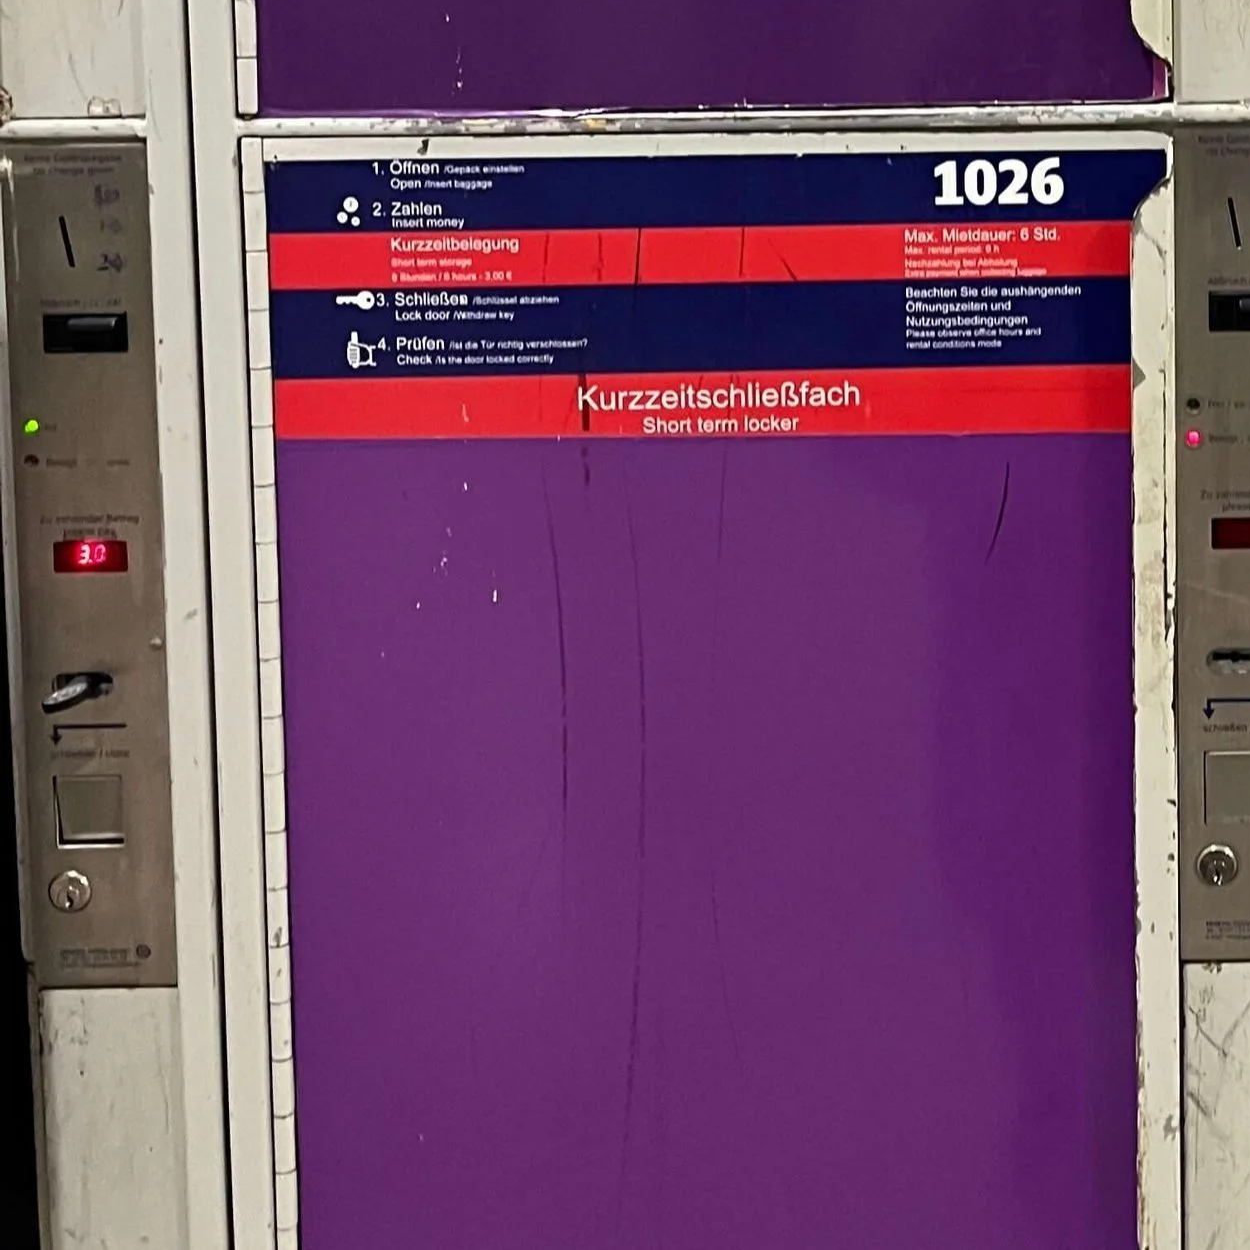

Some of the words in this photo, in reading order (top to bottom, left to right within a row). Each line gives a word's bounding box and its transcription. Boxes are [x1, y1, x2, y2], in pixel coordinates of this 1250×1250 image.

[372, 162, 385, 176] 1.
[389, 159, 440, 175] Öffnen
[390, 177, 421, 191] Open
[933, 156, 1065, 206] 1026
[372, 202, 386, 217] 2.
[390, 202, 443, 217] Zahlen
[391, 217, 424, 228] Insert
[426, 217, 465, 230] money
[904, 227, 939, 243] Max.
[942, 227, 1017, 242] Mietdauer:
[1020, 227, 1030, 242] 6
[1033, 226, 1060, 241] Std.
[390, 237, 520, 254] Kurzzeitbelegung
[905, 286, 957, 299] Beachten
[960, 286, 978, 298] Sie
[981, 286, 998, 297] die
[1001, 285, 1082, 298] aushängenden
[376, 292, 389, 307] 3.
[394, 292, 468, 307] Schließen
[905, 301, 988, 314] Öffnungszeiten
[990, 300, 1012, 311] und
[395, 310, 422, 321] Lock
[424, 309, 450, 321] door
[499, 310, 515, 321] key
[905, 315, 1029, 328] Nutzungsbedingungen
[906, 329, 936, 338] Please
[937, 328, 972, 338] observe
[974, 328, 997, 337] office
[999, 327, 1023, 337] hours
[1025, 327, 1042, 336] and
[377, 336, 390, 351] 4.
[396, 336, 445, 350] Prüfen
[906, 341, 931, 350] rental
[932, 340, 976, 349] conditions
[397, 354, 432, 365] Check
[577, 381, 860, 411] Kurzzeitschließfach
[642, 415, 692, 434] Short
[697, 416, 739, 433] term
[744, 415, 800, 432] locker
